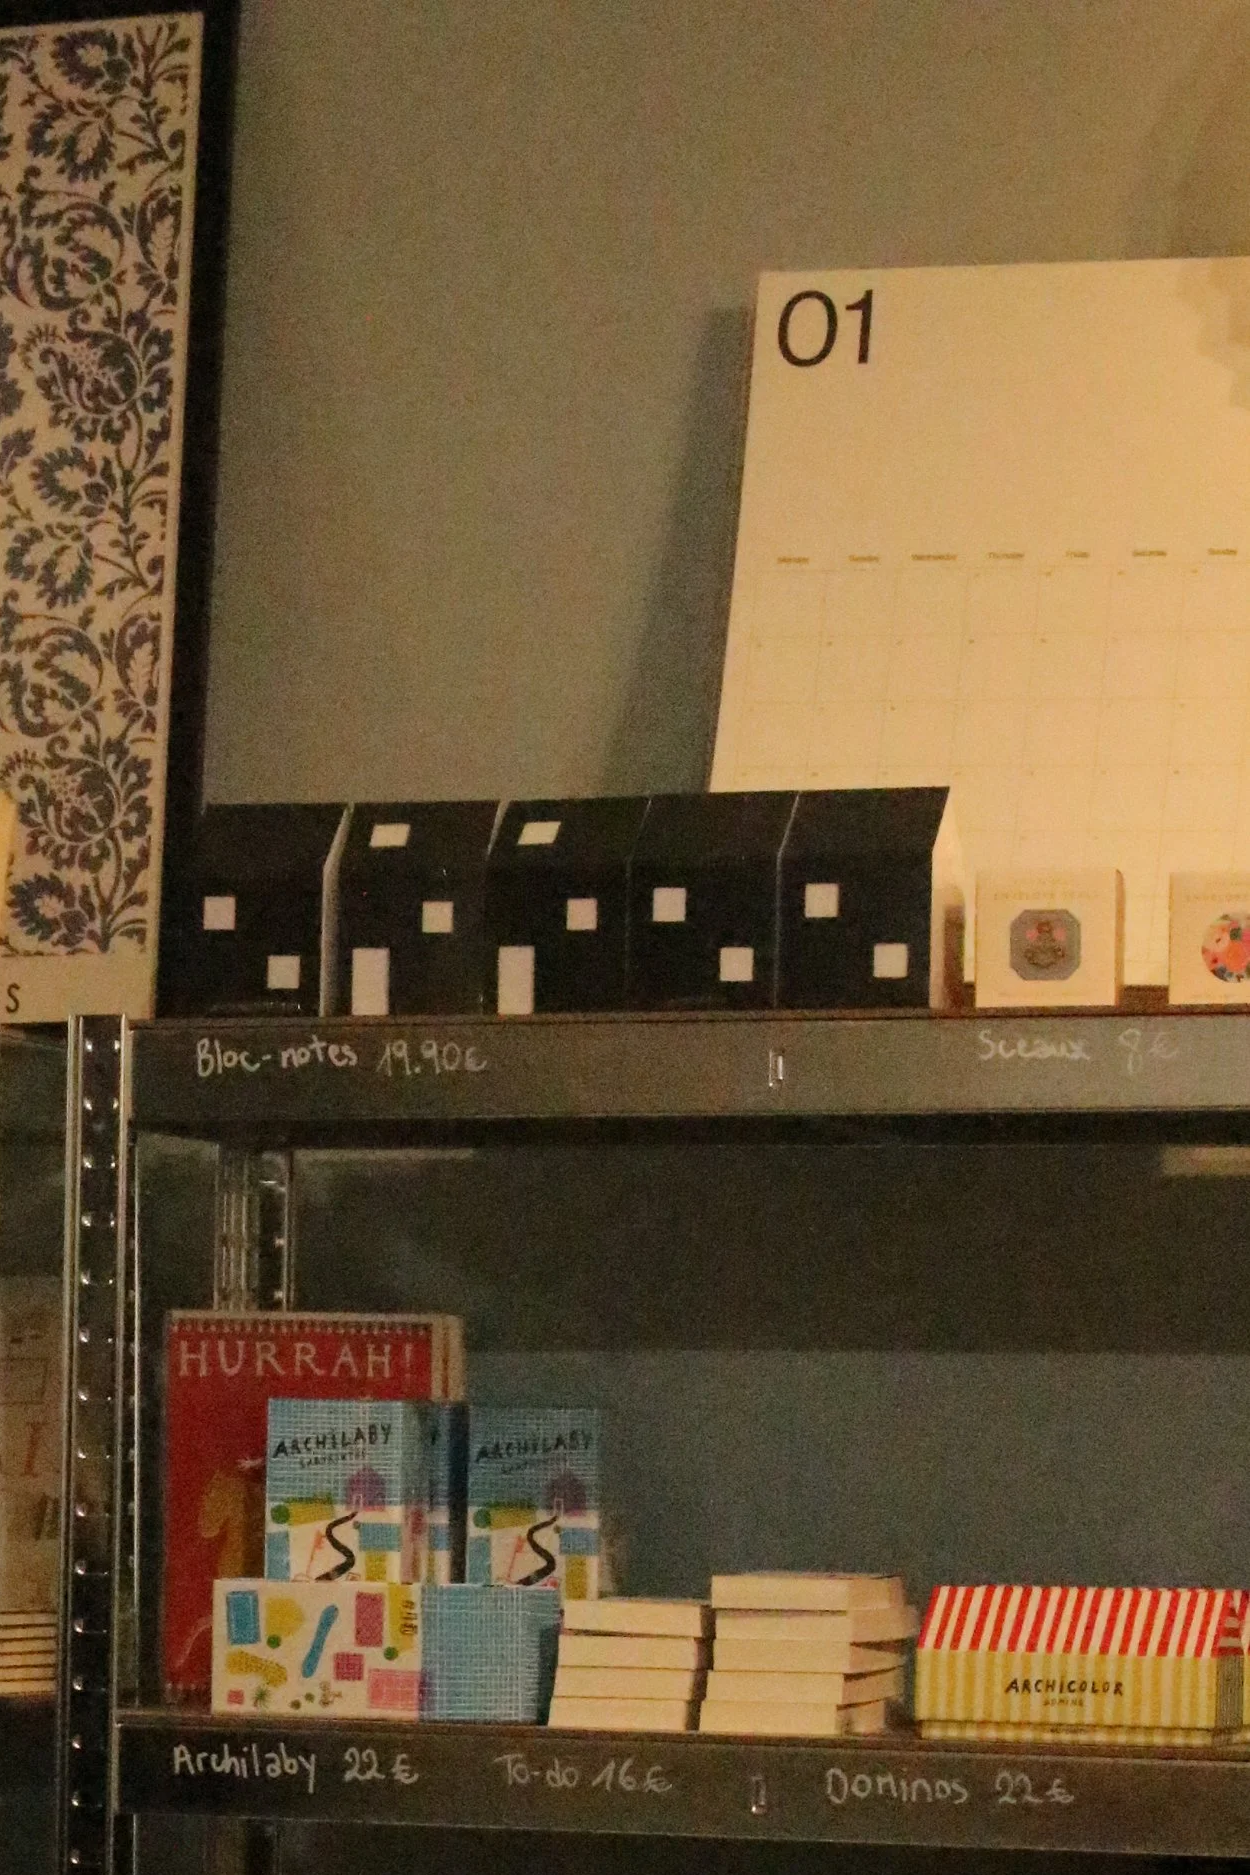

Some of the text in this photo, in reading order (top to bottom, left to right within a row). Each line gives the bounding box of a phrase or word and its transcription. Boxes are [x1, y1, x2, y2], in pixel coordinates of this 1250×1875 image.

[777, 289, 875, 368] 01
[196, 1035, 358, 1077] Bloc-notes
[177, 1340, 413, 1381] HURRAH!
[273, 1423, 391, 1458] ARCHILABY
[1005, 1676, 1123, 1696] ARCHICOLOR
[173, 1743, 317, 1793] Archilaby
[496, 1753, 578, 1789] To-do
